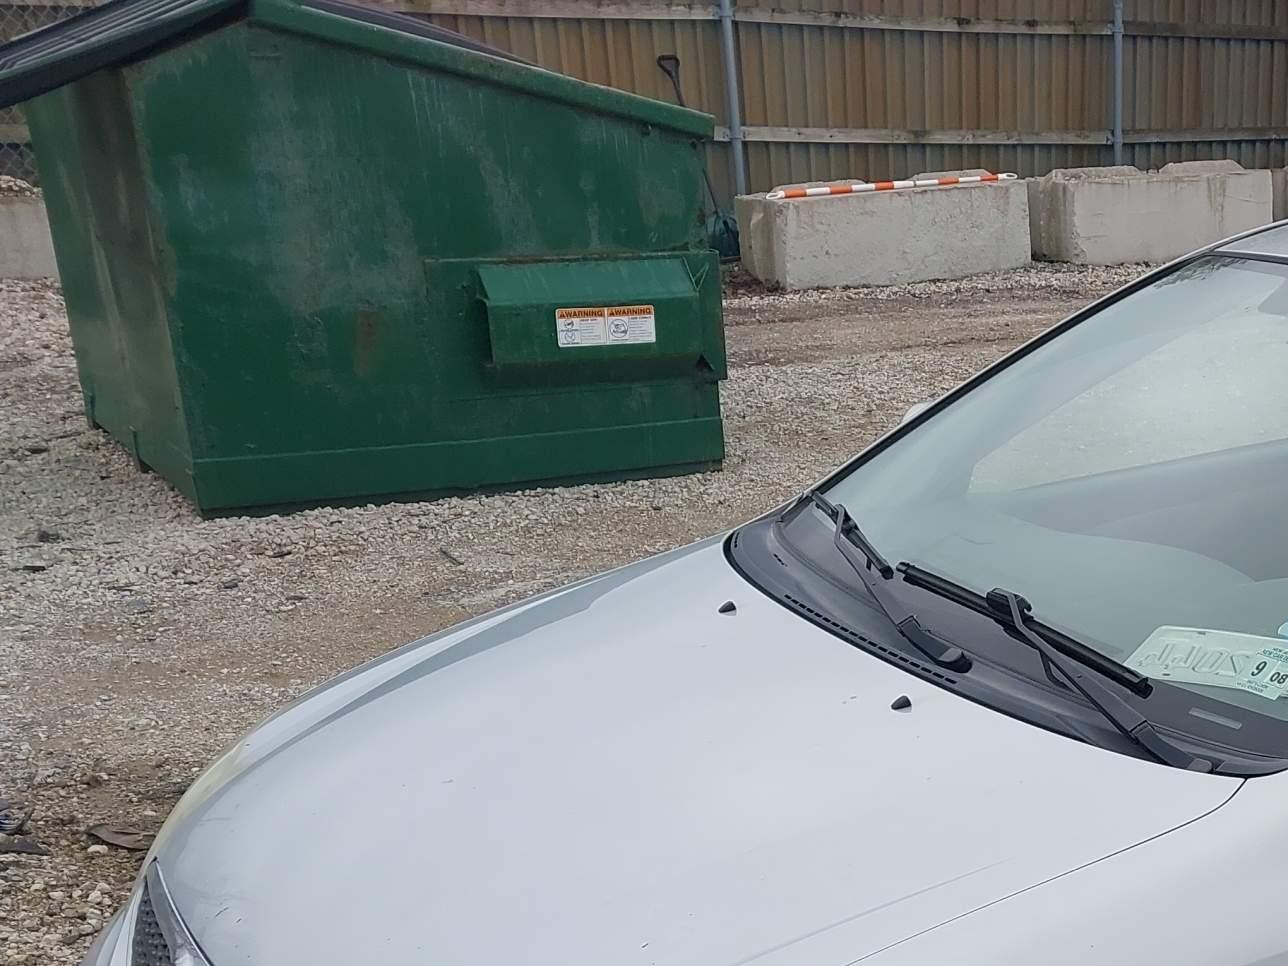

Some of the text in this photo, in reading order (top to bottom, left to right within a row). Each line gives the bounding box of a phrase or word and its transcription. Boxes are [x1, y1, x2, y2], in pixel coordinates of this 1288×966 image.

[566, 309, 603, 318] WARNING
[614, 307, 651, 316] WARNING
[1250, 660, 1268, 677] 9
[1269, 671, 1288, 685] 08
